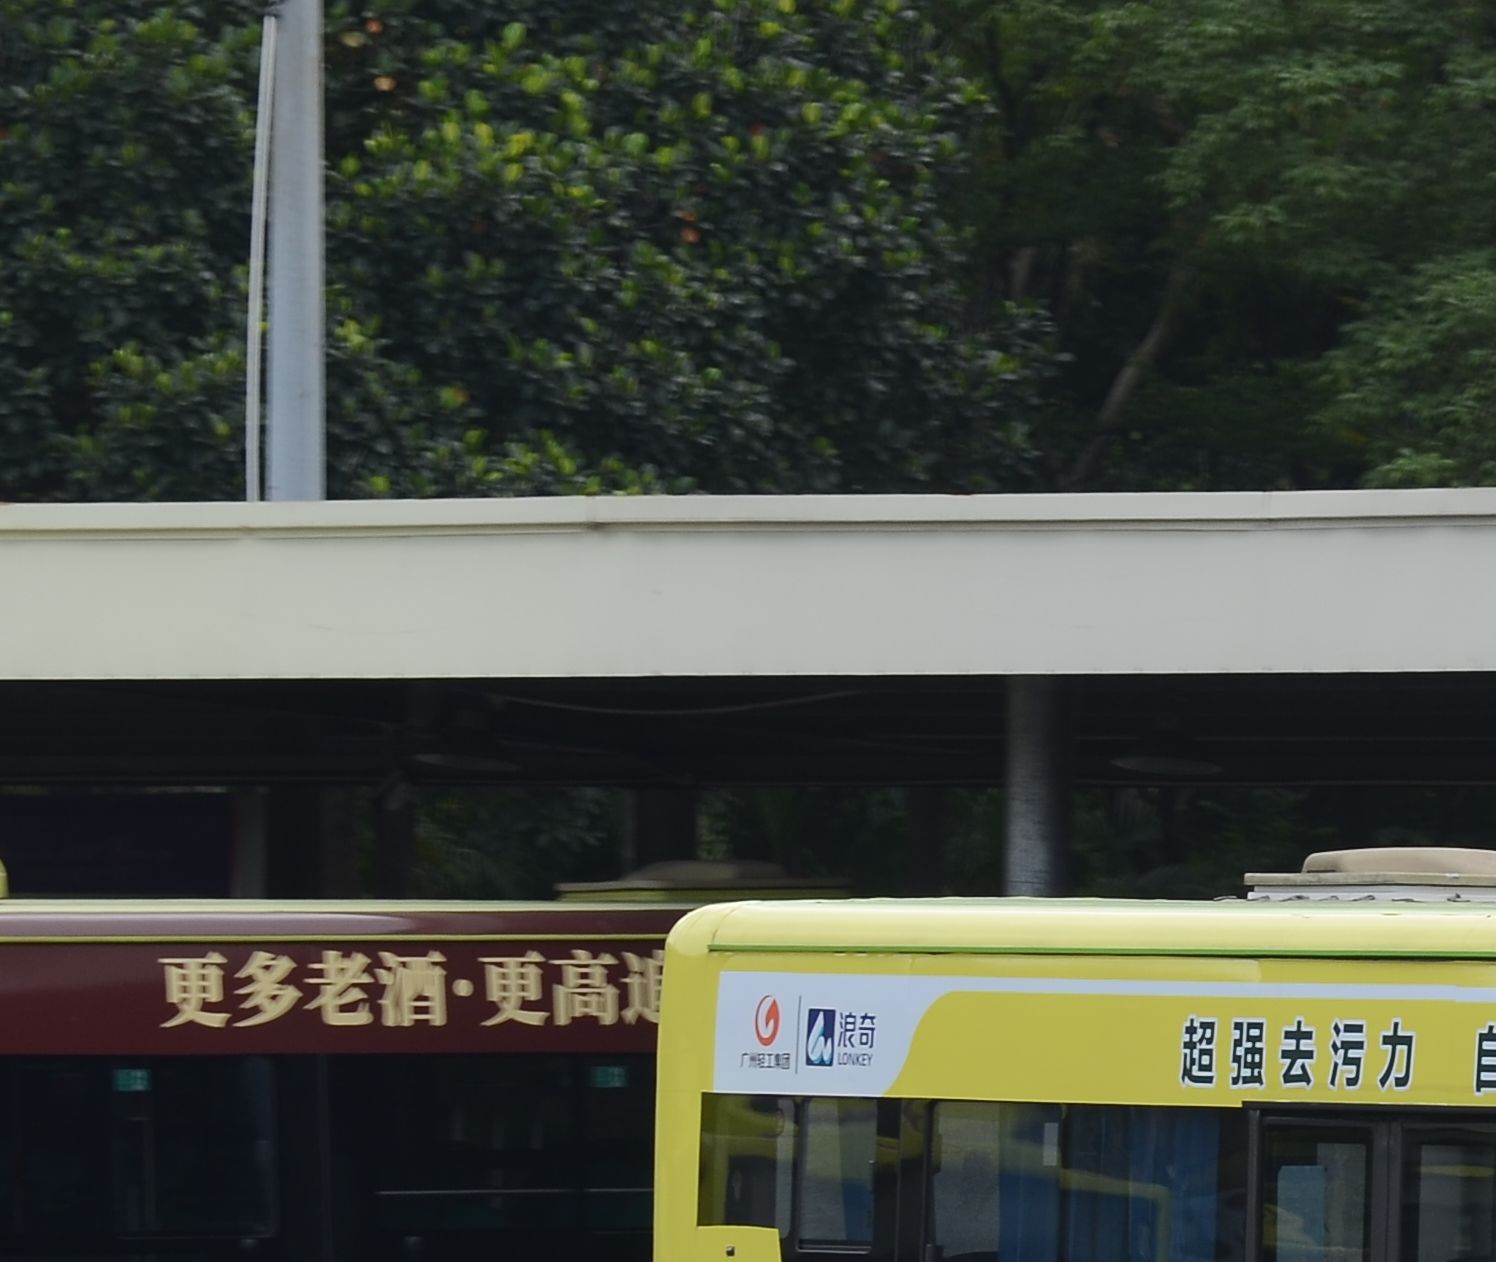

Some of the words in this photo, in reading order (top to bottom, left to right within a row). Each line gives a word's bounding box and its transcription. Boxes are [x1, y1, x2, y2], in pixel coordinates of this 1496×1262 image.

[838, 1012, 876, 1048] 浪奇
[1180, 1018, 1414, 1089] 超强去污力
